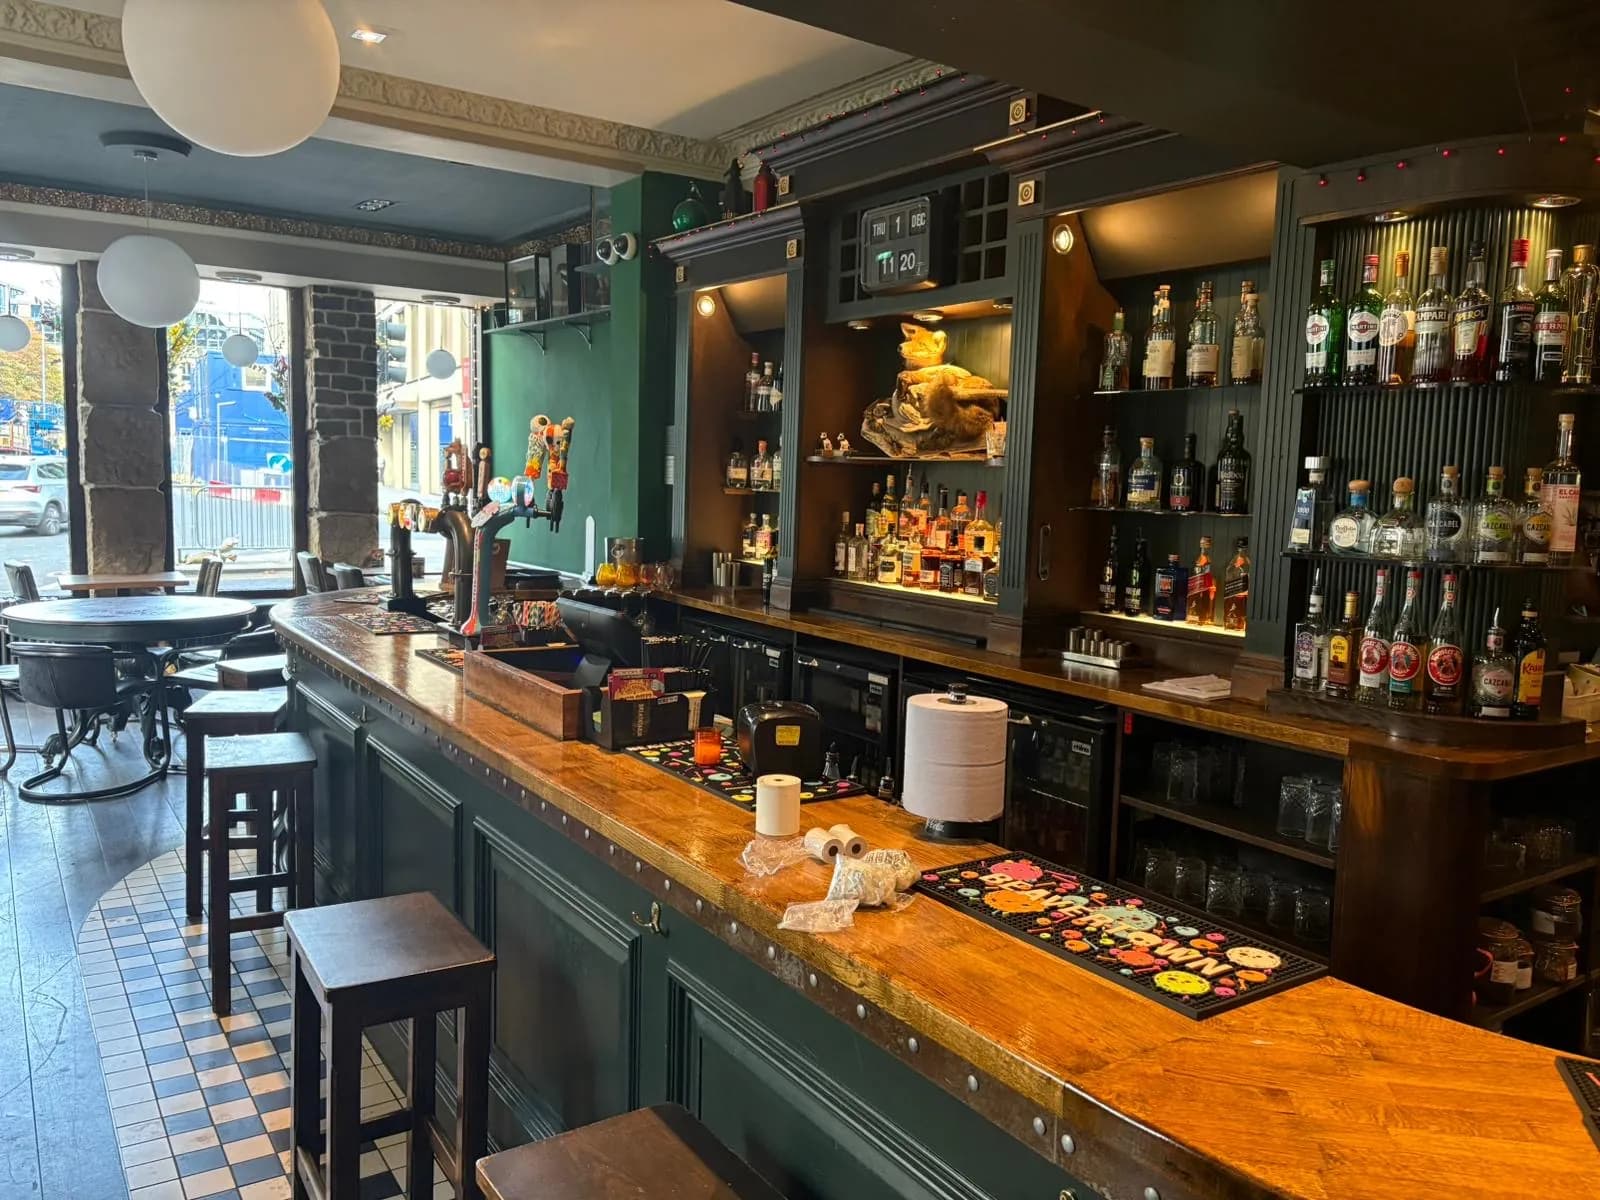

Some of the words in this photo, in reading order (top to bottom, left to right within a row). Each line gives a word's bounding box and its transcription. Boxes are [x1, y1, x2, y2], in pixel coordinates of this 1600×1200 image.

[872, 222, 886, 238] THU
[896, 216, 902, 233] 1
[911, 213, 927, 228] DEC
[900, 252, 915, 272] 20
[979, 872, 1233, 979] BEAVERTOWN
